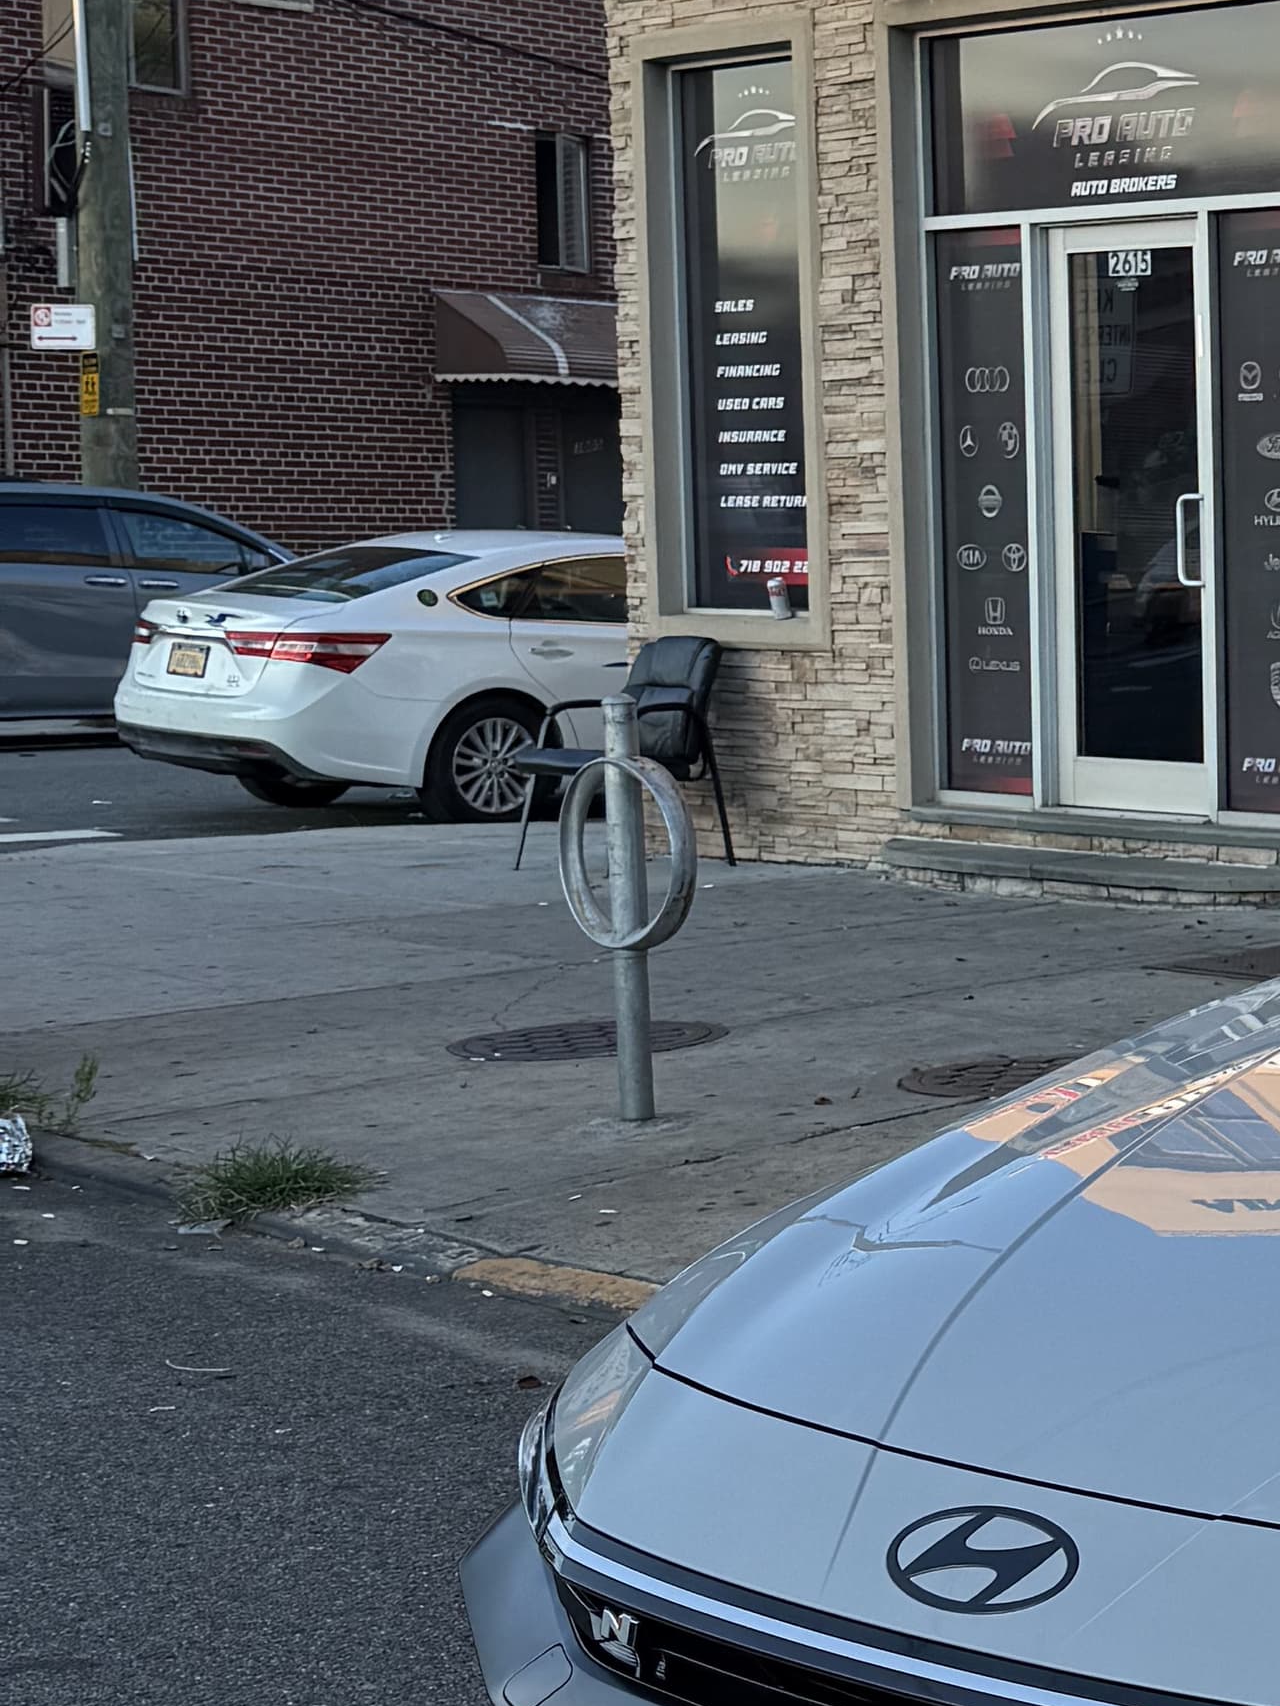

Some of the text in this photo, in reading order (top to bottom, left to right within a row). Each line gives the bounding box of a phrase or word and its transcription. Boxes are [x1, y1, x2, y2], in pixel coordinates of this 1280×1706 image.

[1052, 107, 1197, 149] PRO AUTO
[708, 140, 796, 169] PRO AUT
[1074, 145, 1174, 169] LEASING
[1070, 174, 1178, 198] AUTO BROKERS
[1110, 253, 1151, 275] 2615
[1233, 249, 1268, 266] PRO
[950, 262, 1021, 281] PRO AUTO
[714, 299, 755, 313] SALES
[715, 331, 768, 346] LEASING
[716, 363, 781, 378] FINANCING
[717, 396, 785, 411] USED CARS
[718, 429, 786, 444] INSURANCE
[719, 461, 798, 476] DMV SERVICE
[720, 495, 760, 508] LEASE
[739, 559, 761, 573] 718
[763, 559, 790, 574] 902
[977, 625, 1014, 636] HONDA
[982, 660, 1021, 672] LEXUS
[961, 738, 1032, 756] PRO AUTO
[1241, 756, 1276, 774] PRO
